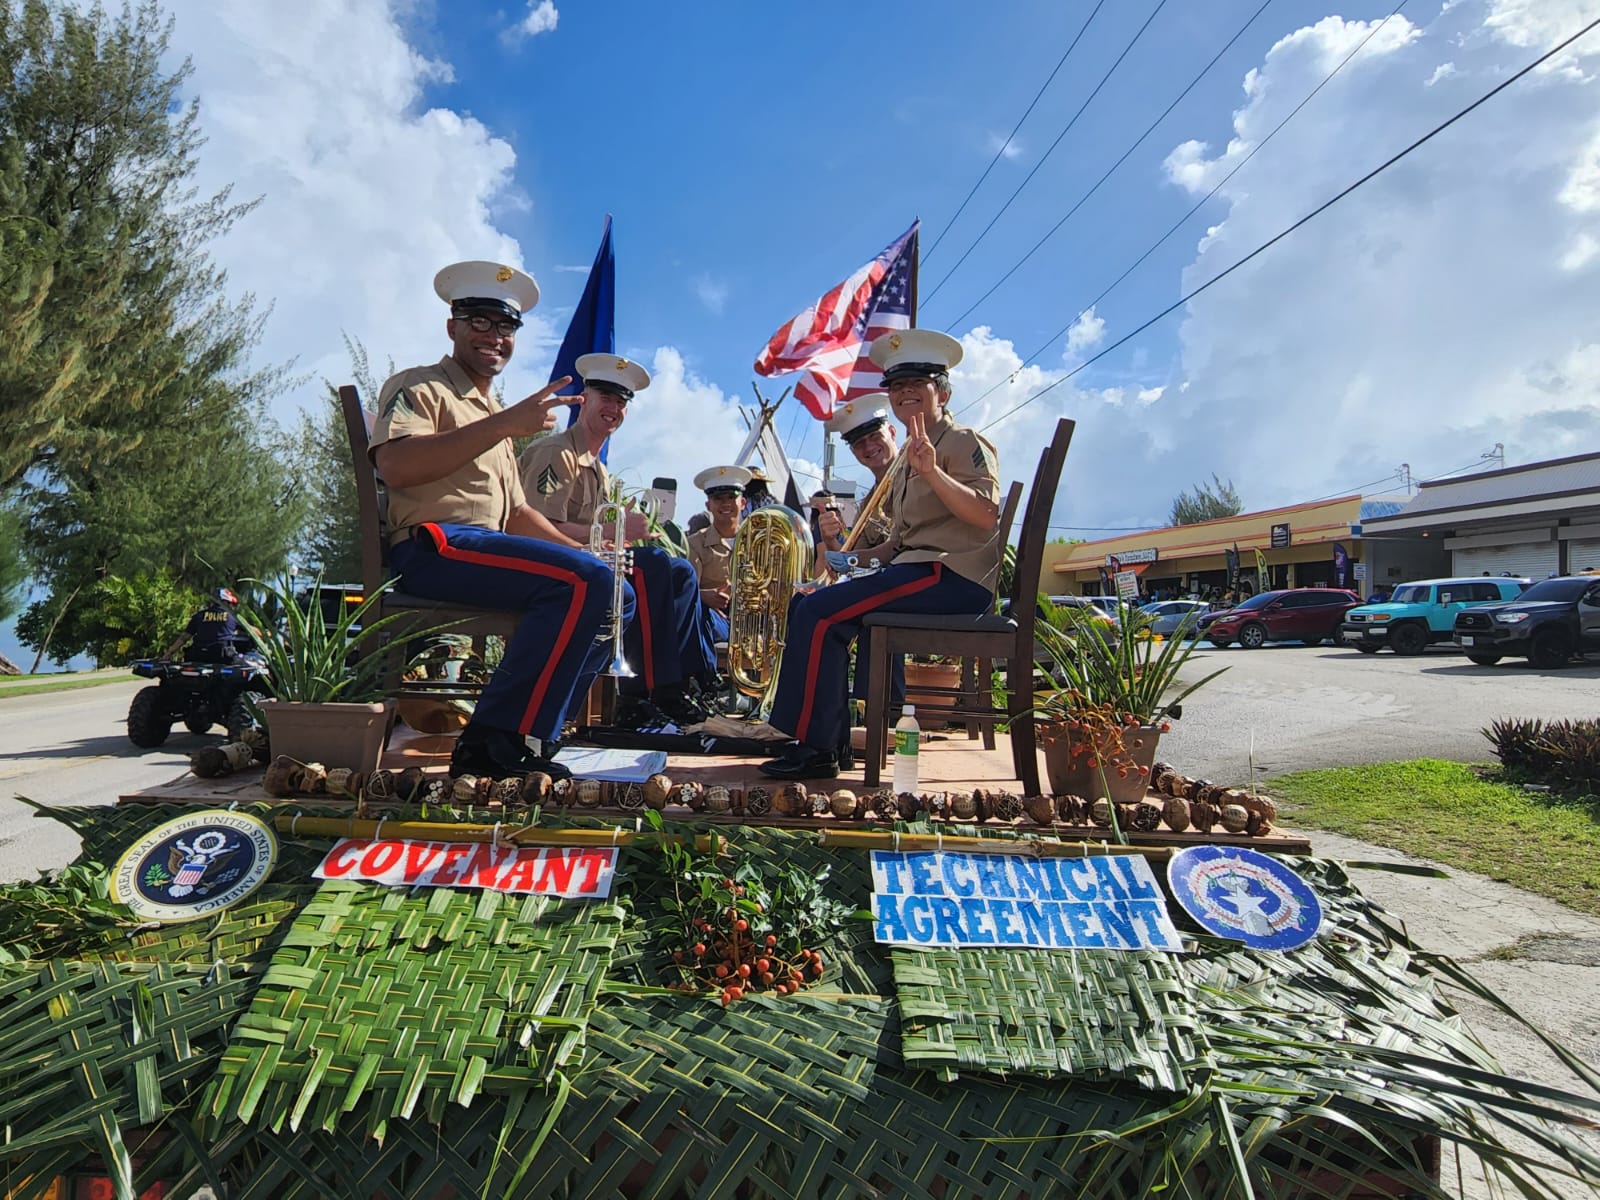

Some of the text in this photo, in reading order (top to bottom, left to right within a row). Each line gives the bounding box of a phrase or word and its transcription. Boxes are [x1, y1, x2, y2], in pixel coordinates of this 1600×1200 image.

[203, 611, 228, 622] POLICE
[118, 816, 270, 913] THE GREAT SEAL OF THE UNITED STATES OF AMERICA
[322, 838, 614, 893] COVENANT
[875, 851, 1157, 901] TECHNICAL
[875, 894, 1170, 948] AGREEMENT
